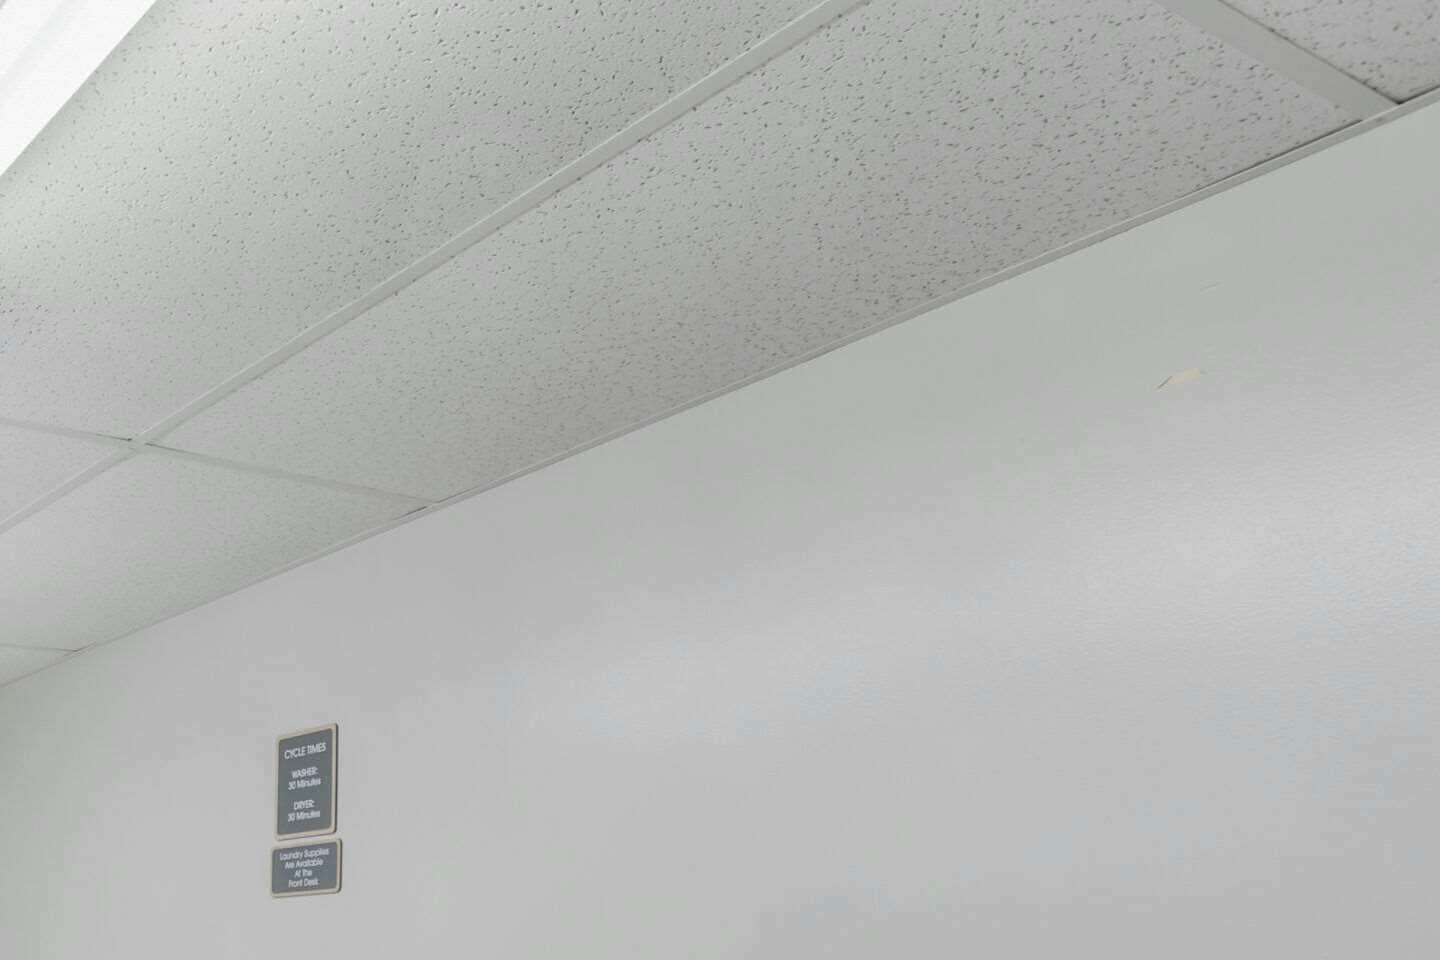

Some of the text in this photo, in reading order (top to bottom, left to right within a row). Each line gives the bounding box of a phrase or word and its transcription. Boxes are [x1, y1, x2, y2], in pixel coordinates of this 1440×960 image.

[284, 743, 326, 760] CYCLE TIMES
[297, 778, 321, 788] Minutes
[296, 810, 321, 820] Minutes
[279, 848, 329, 861] Laundry Supplies
[284, 858, 324, 870] Are Available
[288, 879, 303, 888] Front
